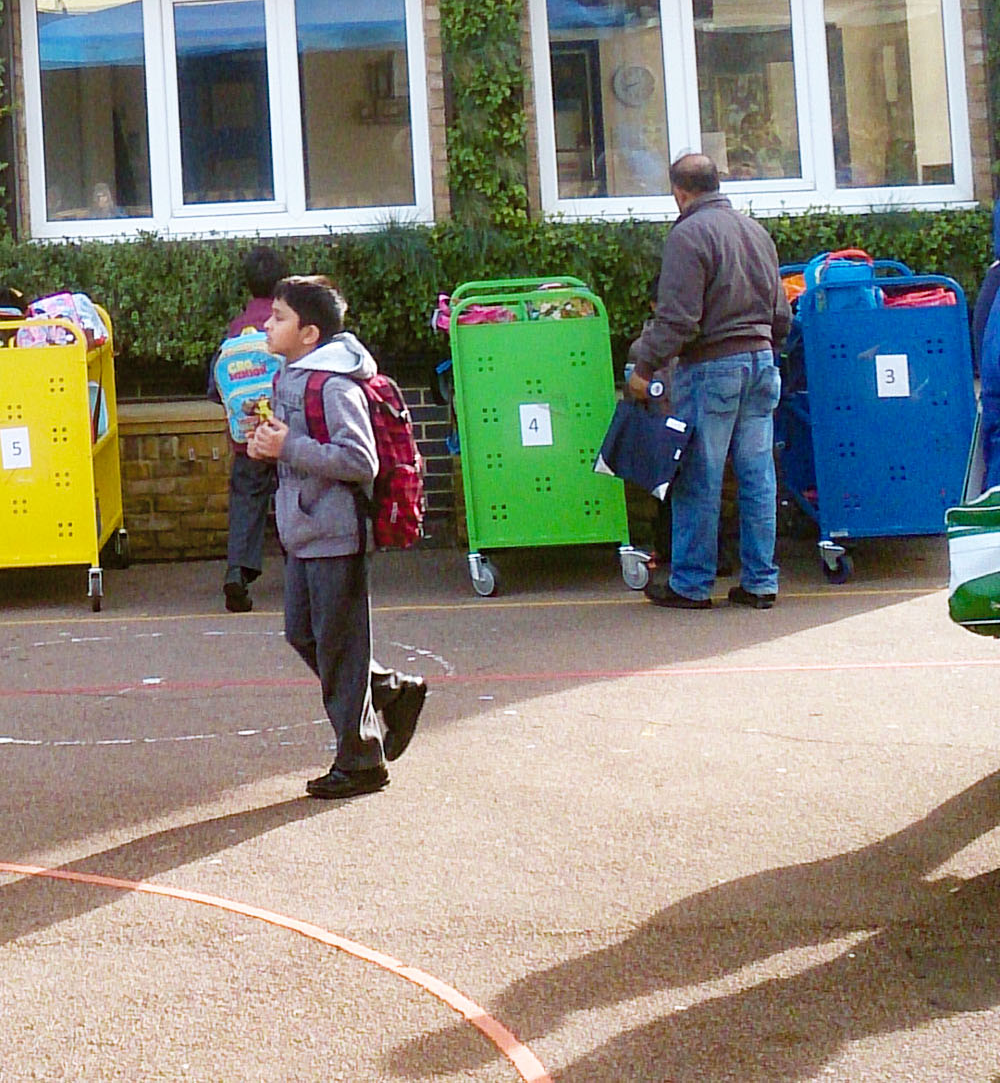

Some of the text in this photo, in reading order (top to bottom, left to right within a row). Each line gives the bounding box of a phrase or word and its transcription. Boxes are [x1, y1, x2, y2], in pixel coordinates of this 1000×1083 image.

[885, 369, 895, 384] 3
[528, 418, 539, 433] 4
[12, 441, 22, 456] 5
